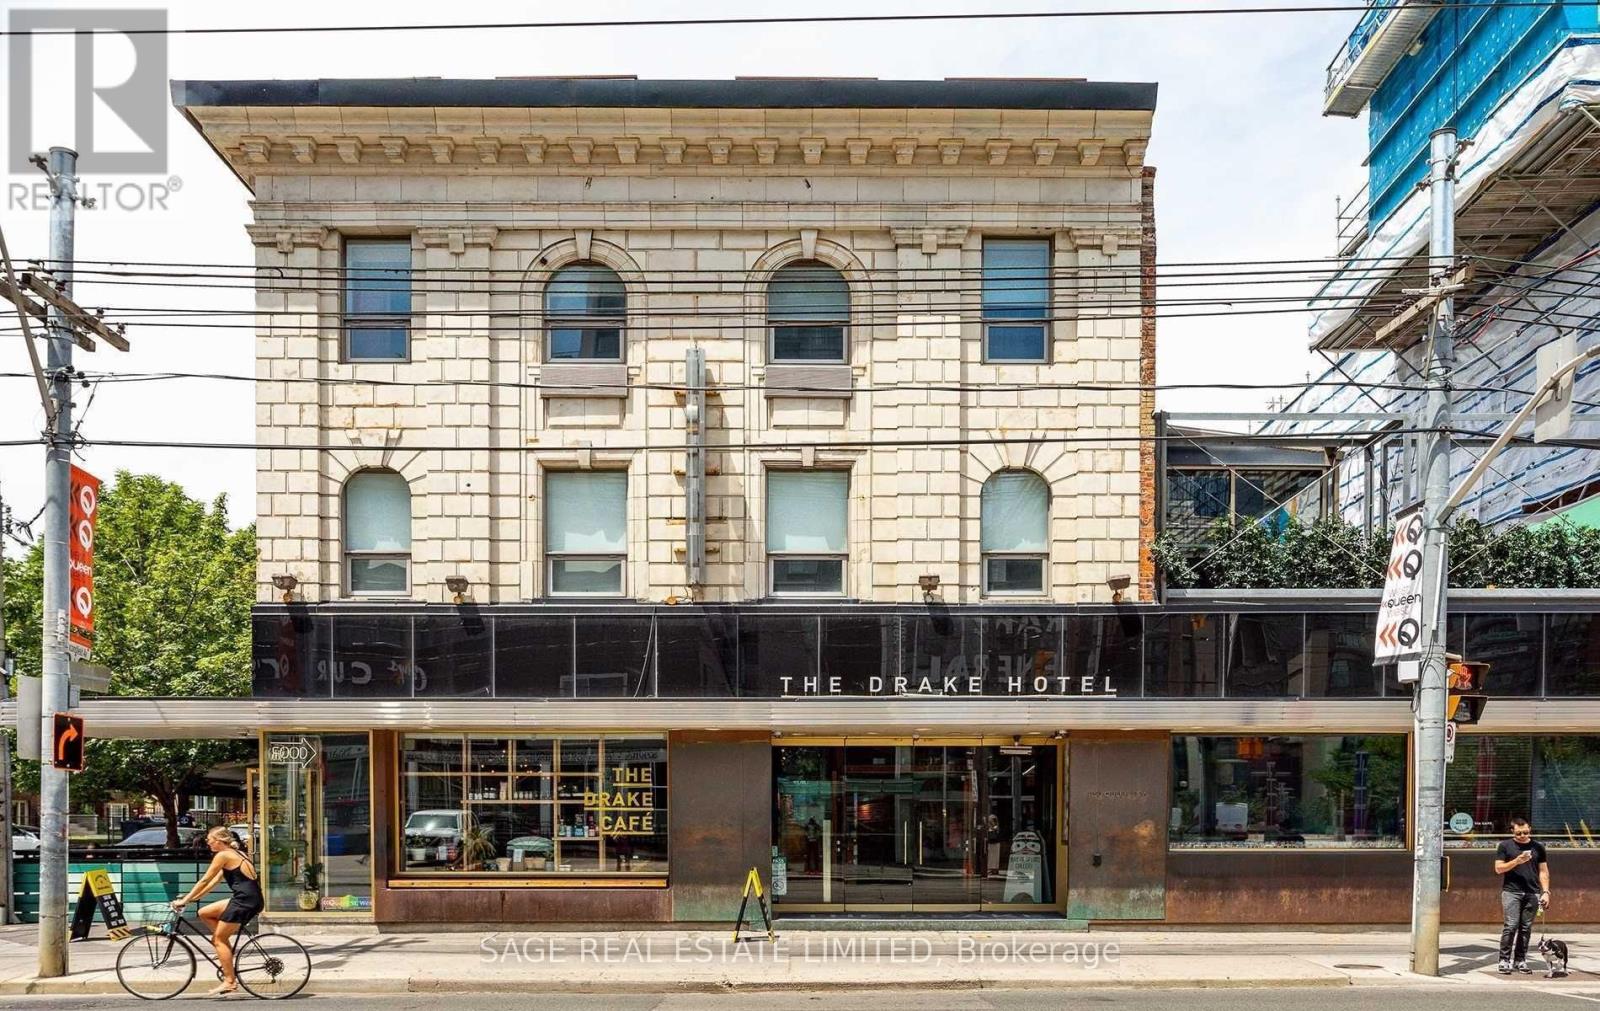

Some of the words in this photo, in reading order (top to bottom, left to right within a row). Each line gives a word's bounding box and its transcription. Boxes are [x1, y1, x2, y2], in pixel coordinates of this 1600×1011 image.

[780, 676, 842, 693] THE
[870, 676, 982, 693] DRAKE
[1009, 676, 1118, 693] HOTEL
[272, 746, 308, 760] FOOD
[612, 768, 652, 782] THE
[584, 791, 653, 806] DRAKE
[601, 812, 654, 831] CAFÉ
